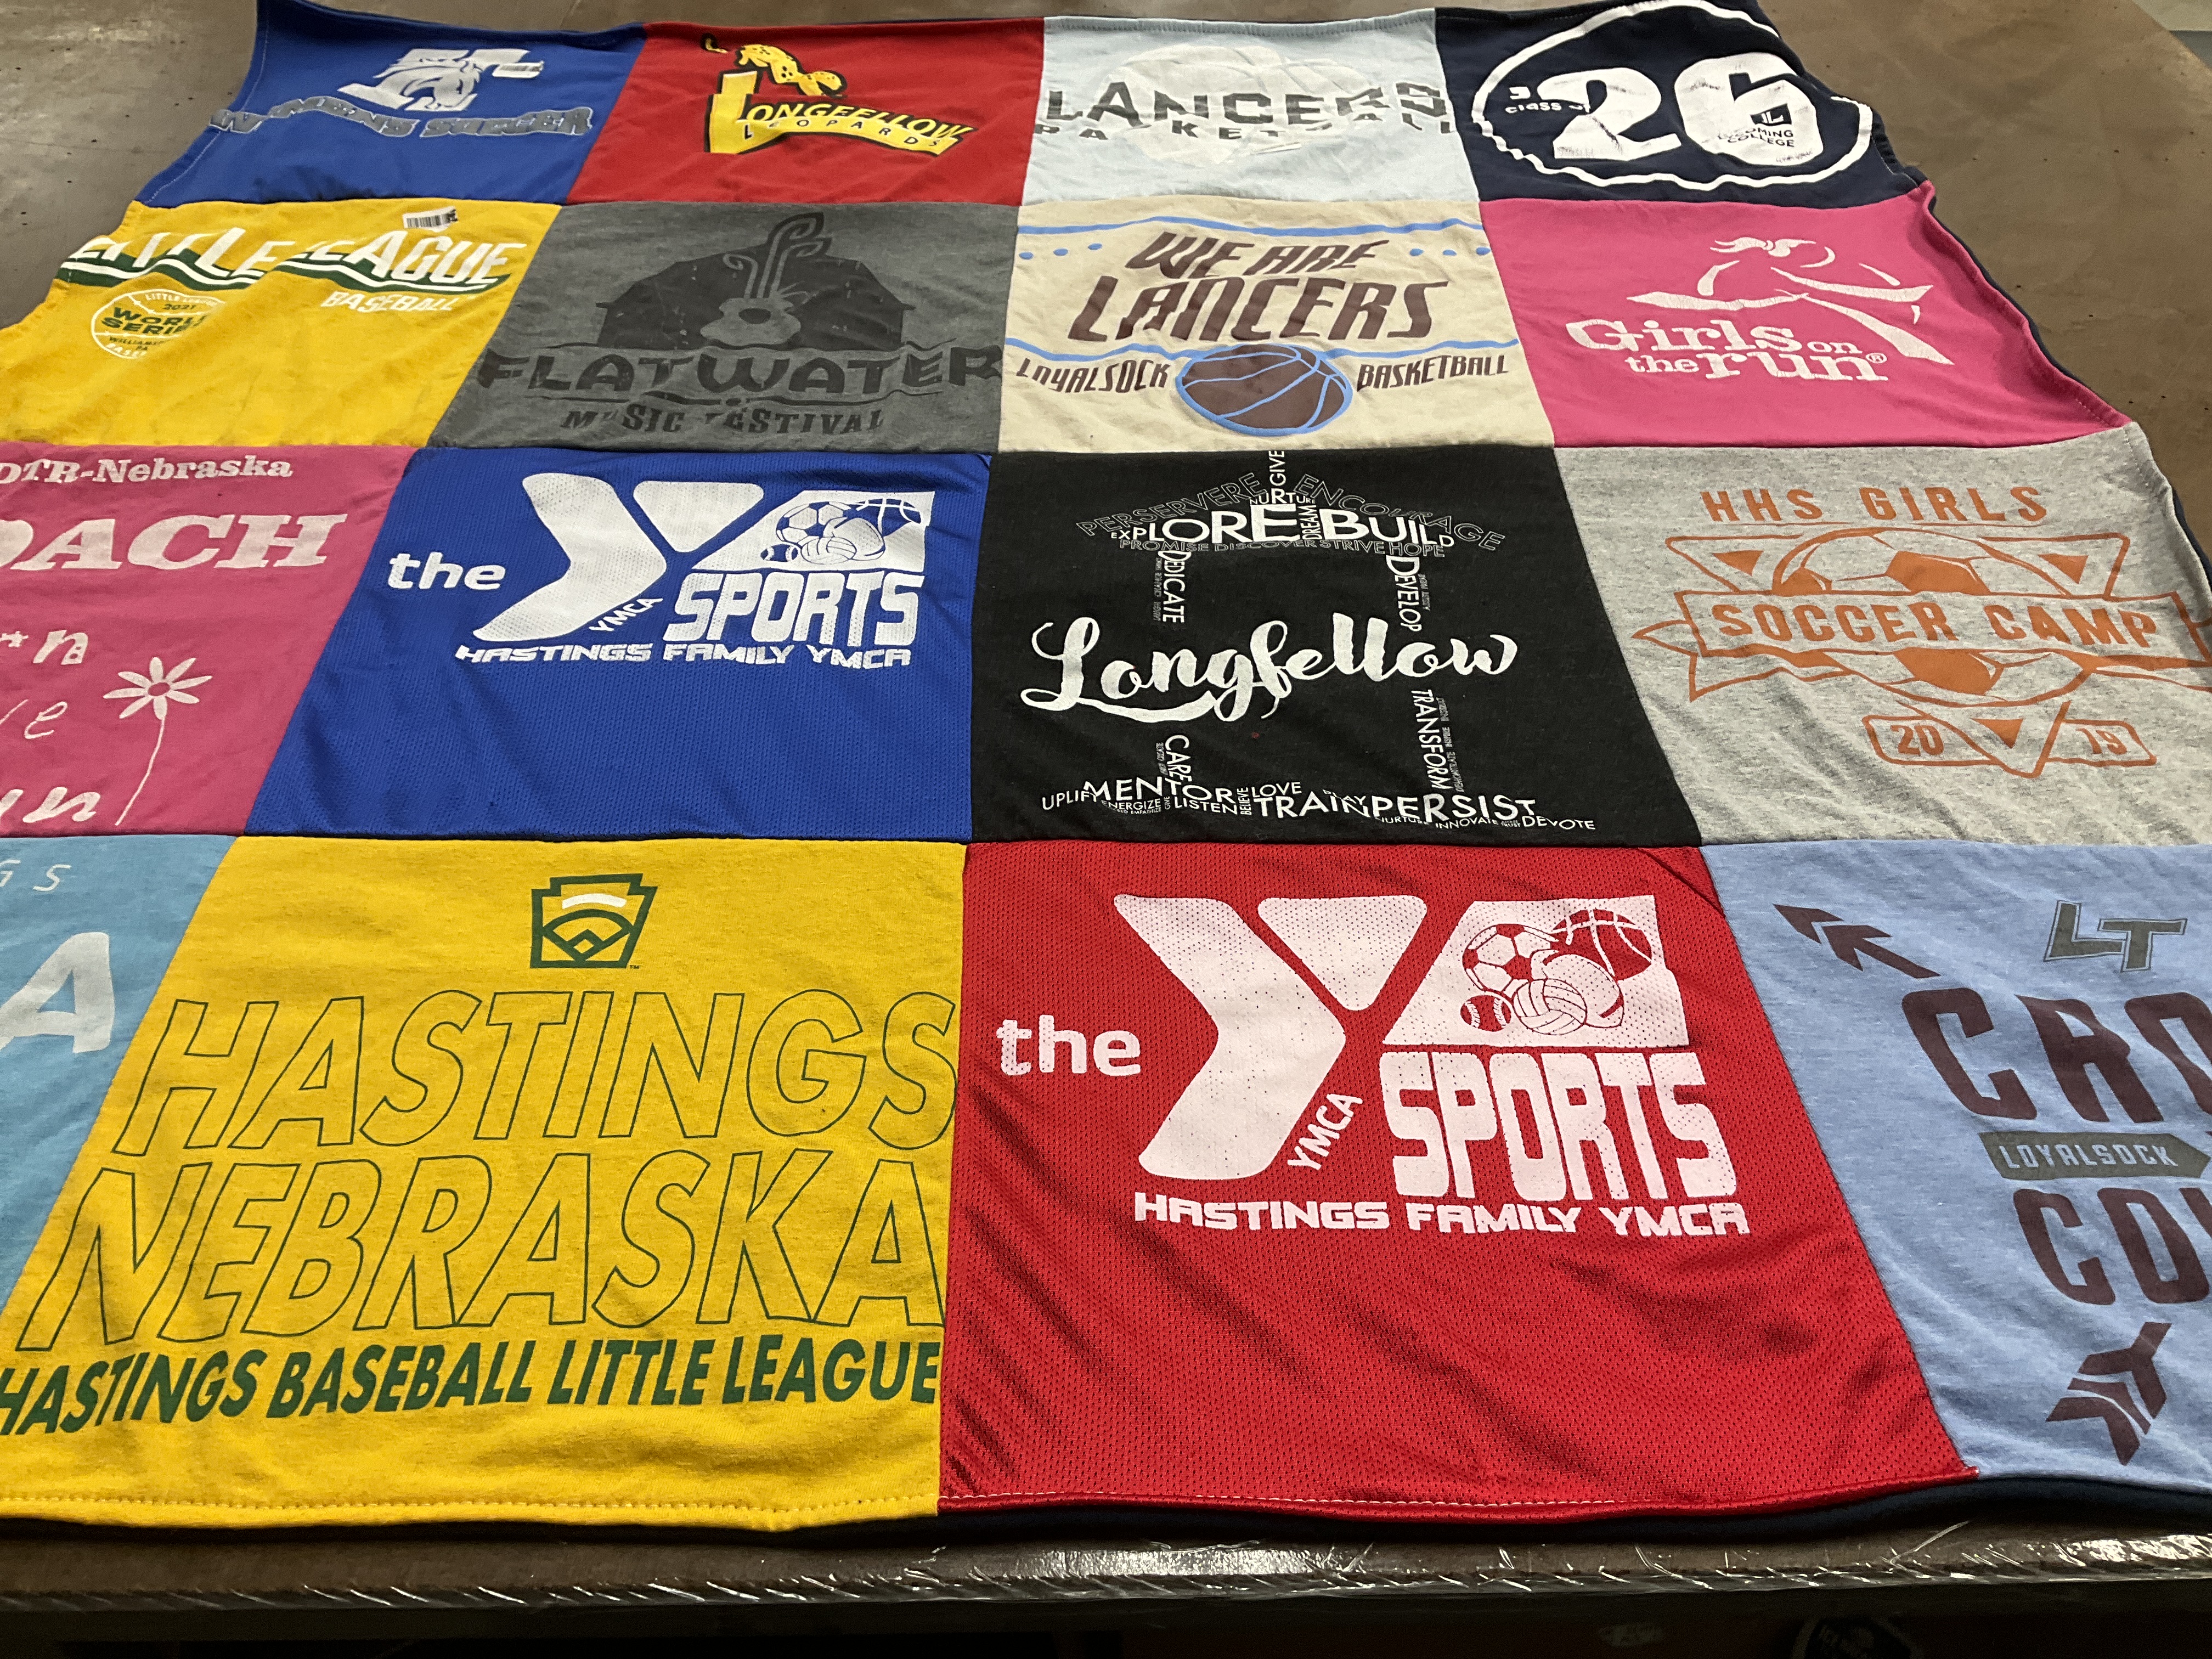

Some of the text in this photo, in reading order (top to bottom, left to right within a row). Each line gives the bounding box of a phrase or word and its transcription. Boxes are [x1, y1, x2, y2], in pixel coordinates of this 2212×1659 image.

[1047, 82, 1447, 129] LANCERS
[1126, 232, 1390, 279] WE ARE
[320, 291, 459, 313] BASEBALL
[1066, 275, 1448, 342] LANCERS
[1566, 319, 1863, 354] Girls on
[478, 345, 1004, 394] FLATWATER
[1356, 354, 1509, 390] BASKETBALL
[1624, 354, 1700, 373] the
[560, 403, 684, 432] MSIC
[1268, 450, 1286, 486] GIVE
[1076, 472, 1268, 537] PERSERVERE
[1297, 505, 1323, 540] DREAM
[1700, 486, 2047, 522] HHS GIRLS
[1110, 504, 1301, 544] EXPLORE
[1319, 509, 1455, 548] BUILD
[1119, 539, 1445, 557] PROMISE DISCOVER STRIVE HOPE
[387, 551, 506, 591] the
[1158, 550, 1192, 623] DEDICATE
[663, 571, 924, 647] SPORTS
[1386, 555, 1422, 631] DEVELOP
[589, 595, 663, 634] YMCA
[1711, 601, 2158, 648] SOCCER CAMP
[455, 643, 911, 670] HASTINGS FAMILY YMCA
[1020, 612, 1518, 723] Longfellow
[1165, 735, 1192, 782] CARE
[1411, 689, 1454, 789] TRANSFORM
[1891, 724, 2129, 757] 20 19
[1042, 790, 1097, 810] UPLIFT
[1083, 776, 1237, 804] MENTOR
[1101, 798, 1162, 811] ENERGIZE
[1175, 796, 1238, 815] LISTEN
[1237, 786, 1252, 816] BELIEVE
[1251, 782, 1302, 799] LOVE
[1372, 793, 1536, 823] PERSIST
[1522, 816, 1596, 831] DEVOTE
[996, 1014, 1142, 1076] the
[115, 989, 956, 1155] HASTINGS
[1287, 1091, 1363, 1172] YMCA
[1379, 1051, 1736, 1201] SPORTS
[1998, 1140, 2179, 1170] LOYALSOCK
[1135, 1192, 1750, 1237] HASTINGS FAMILY YMCA
[16, 1149, 945, 1351] NEBRASKA
[2013, 1187, 2212, 1305] CO
[0, 1334, 941, 1436] HASTINGS BASEBALL LITTLE LEAGUE
